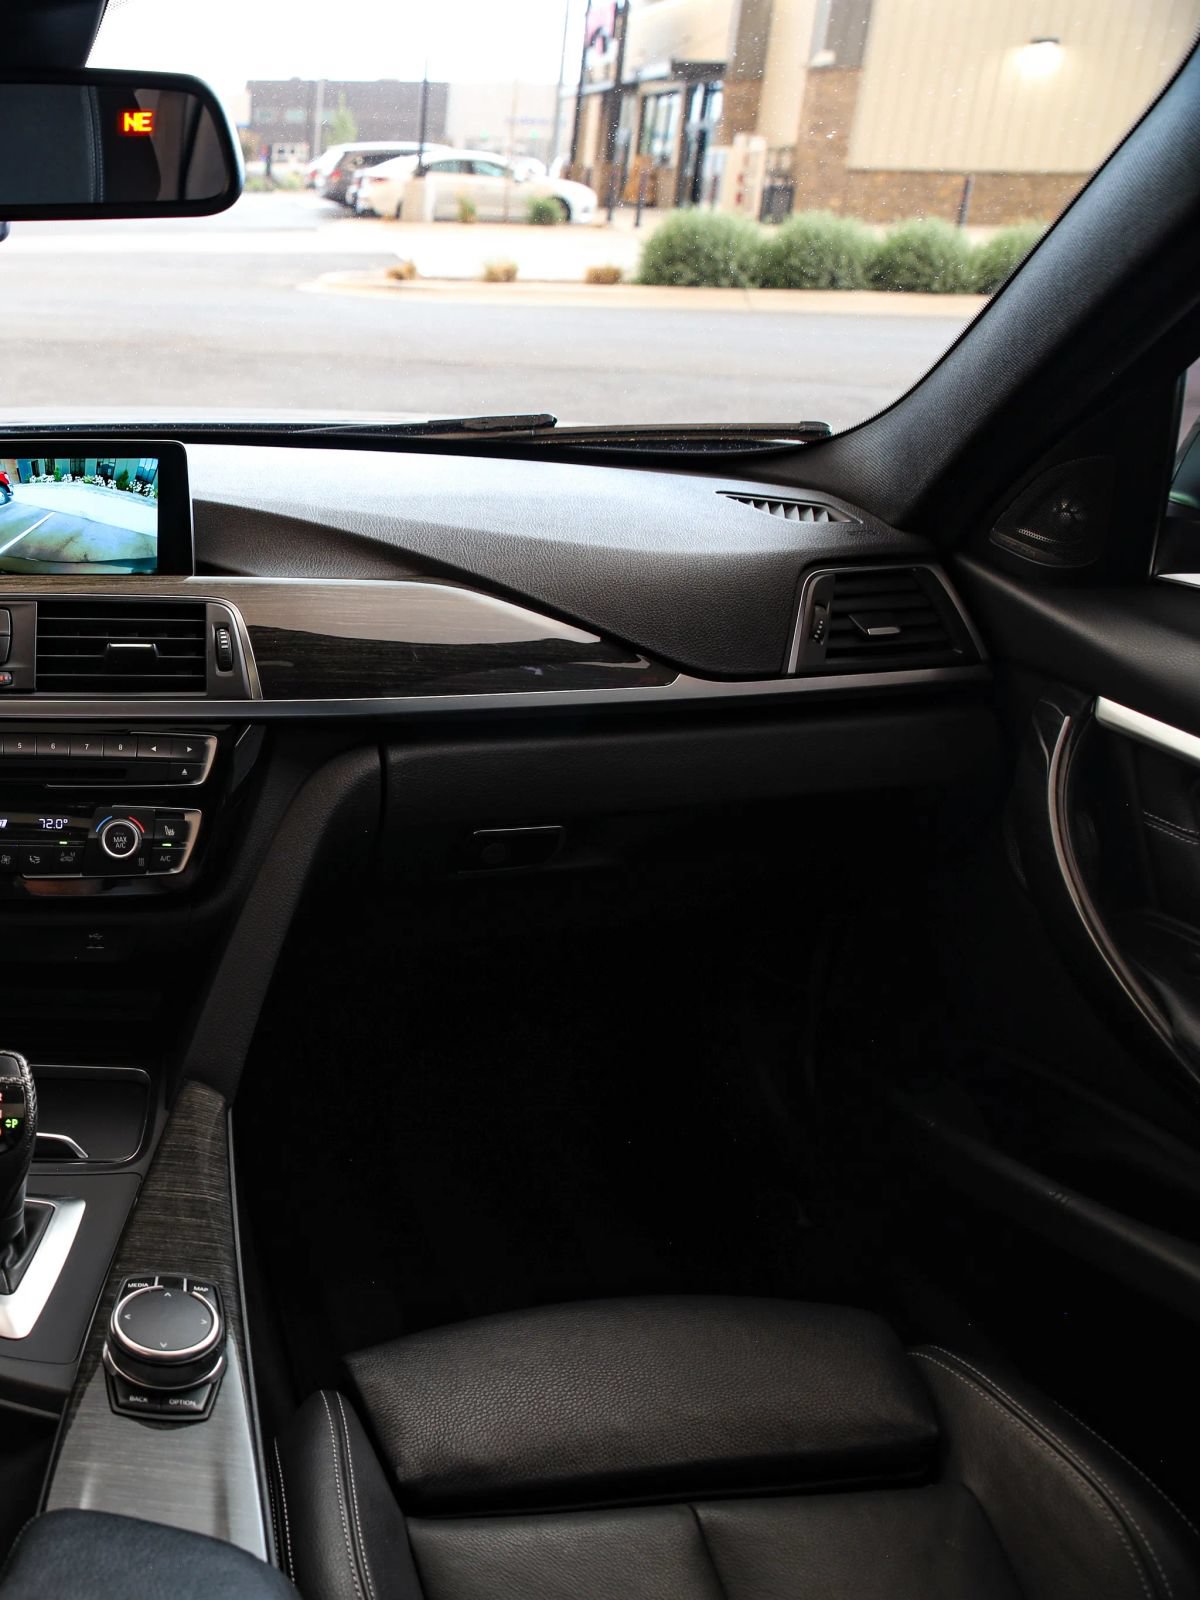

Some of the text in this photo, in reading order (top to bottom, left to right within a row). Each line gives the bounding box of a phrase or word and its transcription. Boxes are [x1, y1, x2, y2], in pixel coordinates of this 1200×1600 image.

[124, 112, 153, 131] NE
[129, 1395, 149, 1403] BACK
[169, 1398, 197, 1406] OPTION
